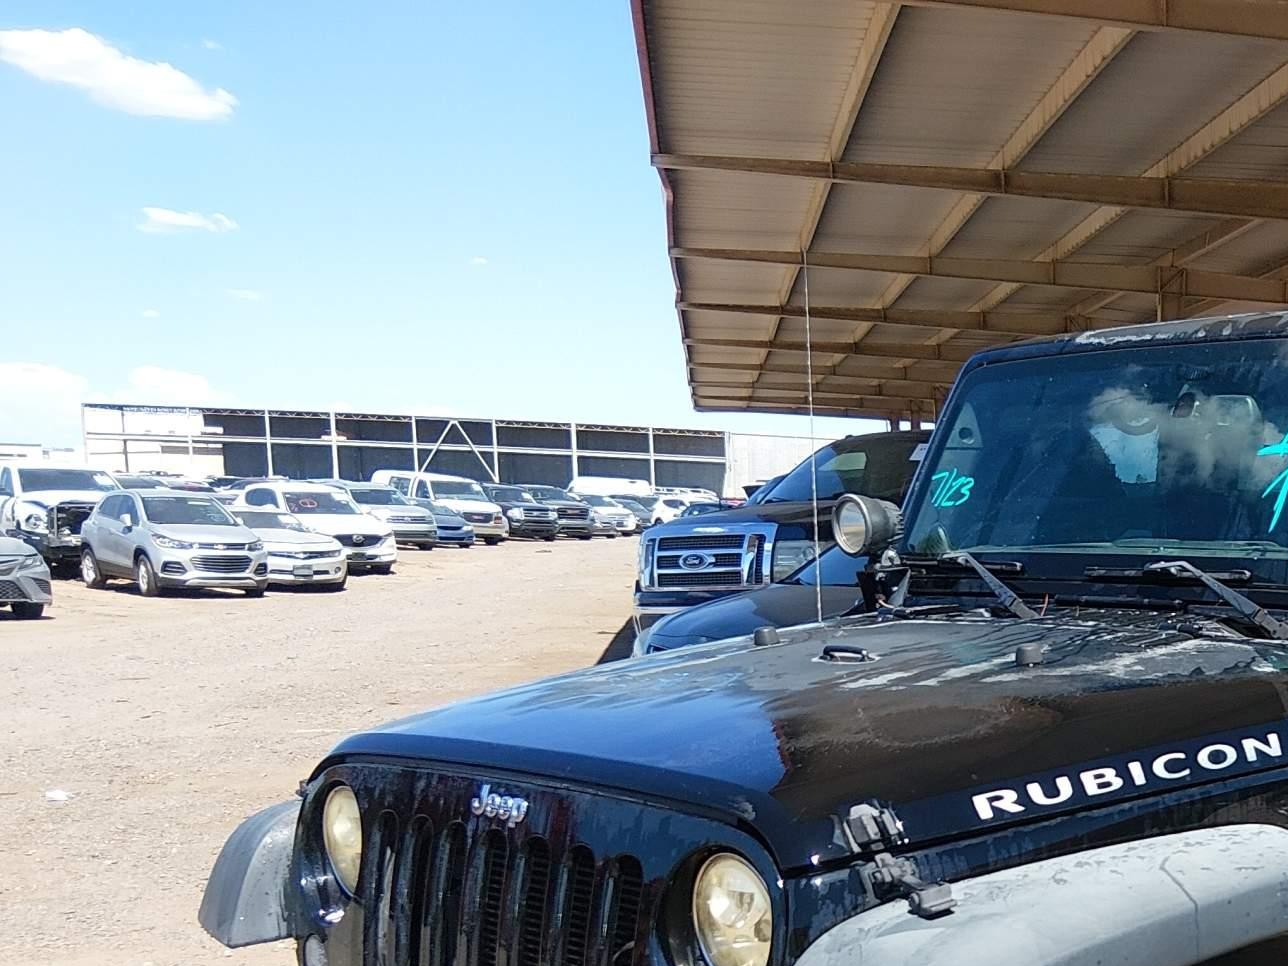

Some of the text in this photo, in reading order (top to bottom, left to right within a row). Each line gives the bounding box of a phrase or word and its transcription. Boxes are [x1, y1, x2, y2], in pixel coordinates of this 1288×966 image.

[931, 467, 975, 507] 7/23
[971, 732, 1283, 821] RUBICON
[471, 784, 529, 828] Jeep
